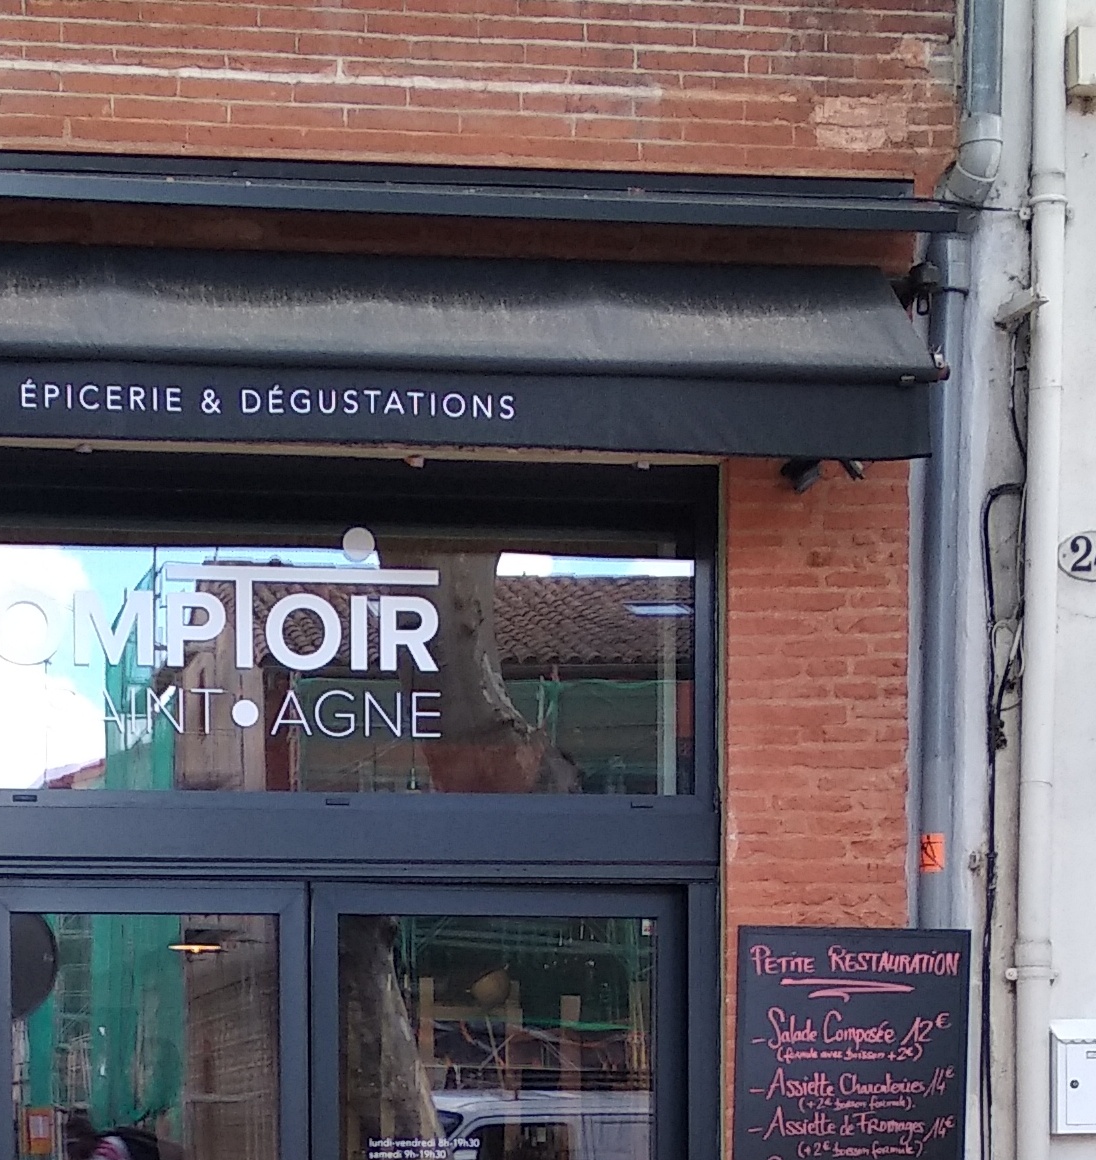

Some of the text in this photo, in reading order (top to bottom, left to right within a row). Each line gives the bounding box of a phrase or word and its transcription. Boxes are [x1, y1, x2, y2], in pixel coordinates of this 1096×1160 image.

[19, 378, 516, 420] ÉPICERIE & DÉGUSTATIONS
[1070, 535, 1096, 572] 2
[767, 1006, 818, 1050] Salade
[823, 1009, 896, 1051] Composée
[766, 1066, 836, 1100] Assiette
[368, 1137, 481, 1149] lundi-vendredi 8h-19h30
[762, 1105, 836, 1142] Assiette
[840, 1114, 855, 1137] de
[853, 1110, 925, 1146] Fromages
[368, 1149, 448, 1160] samedi 9h-19h30
